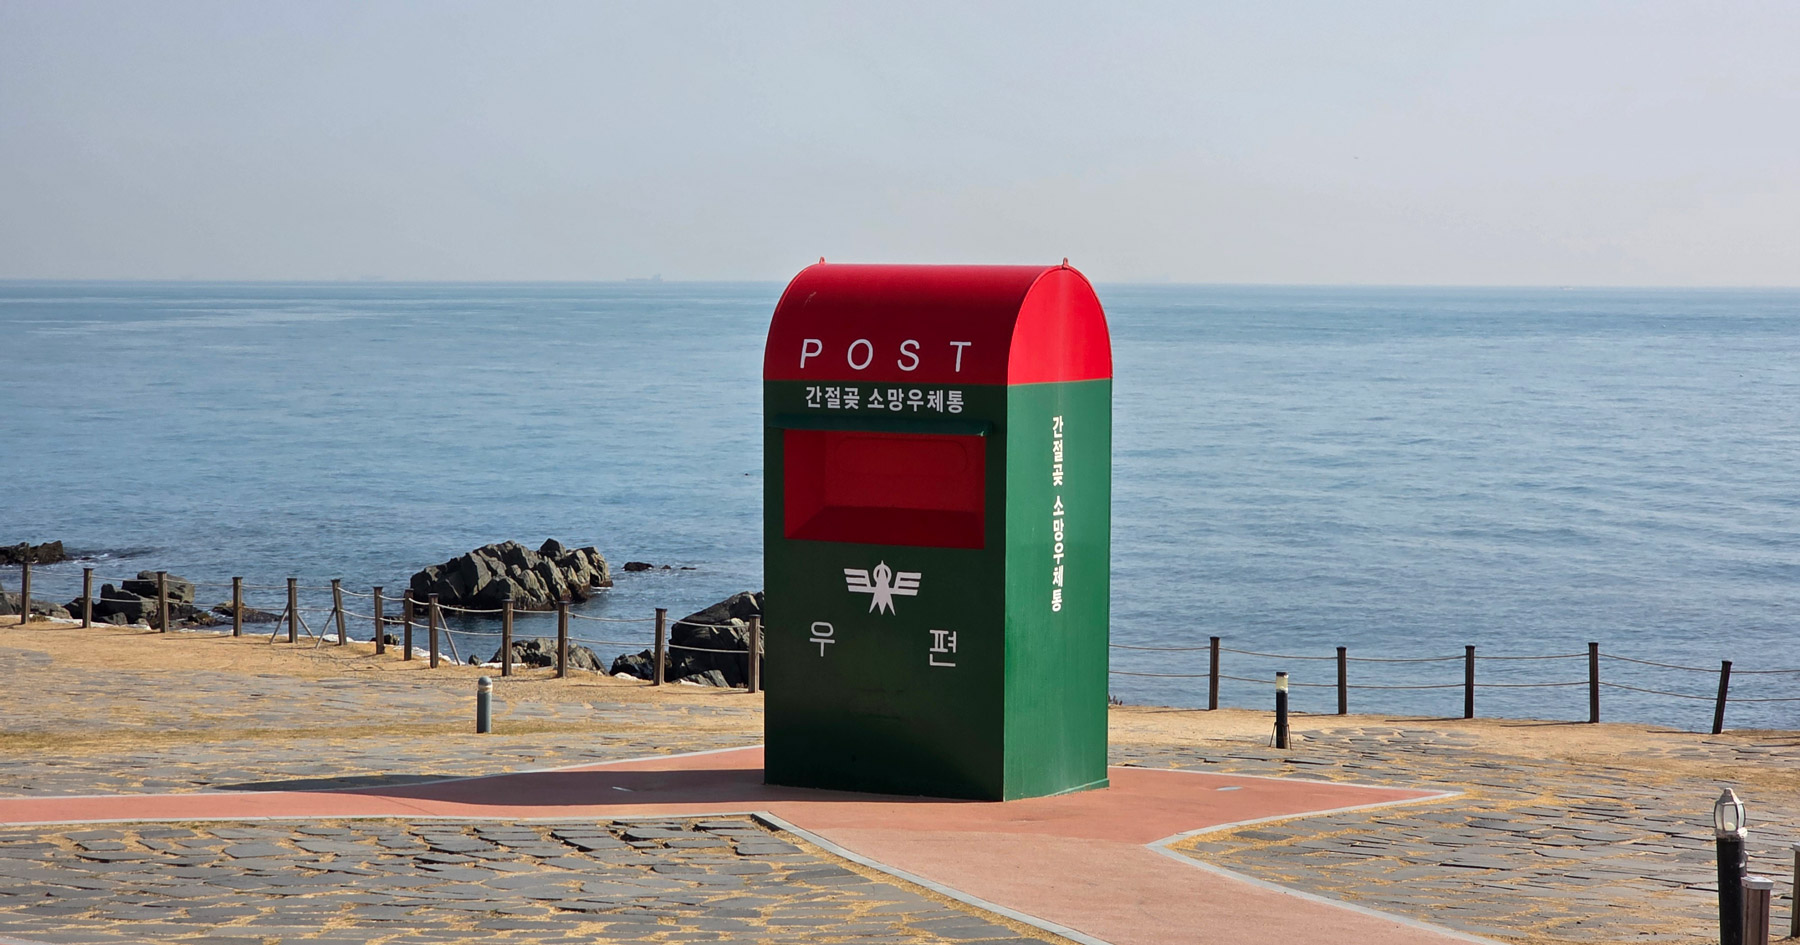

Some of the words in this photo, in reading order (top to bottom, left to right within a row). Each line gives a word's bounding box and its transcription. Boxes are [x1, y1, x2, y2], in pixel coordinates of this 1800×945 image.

[800, 338, 972, 373] POST
[805, 386, 860, 410] 간절곶
[867, 388, 964, 413] 소망우체통
[1052, 415, 1064, 487] 간절곶
[1051, 495, 1065, 612] 소망우체통
